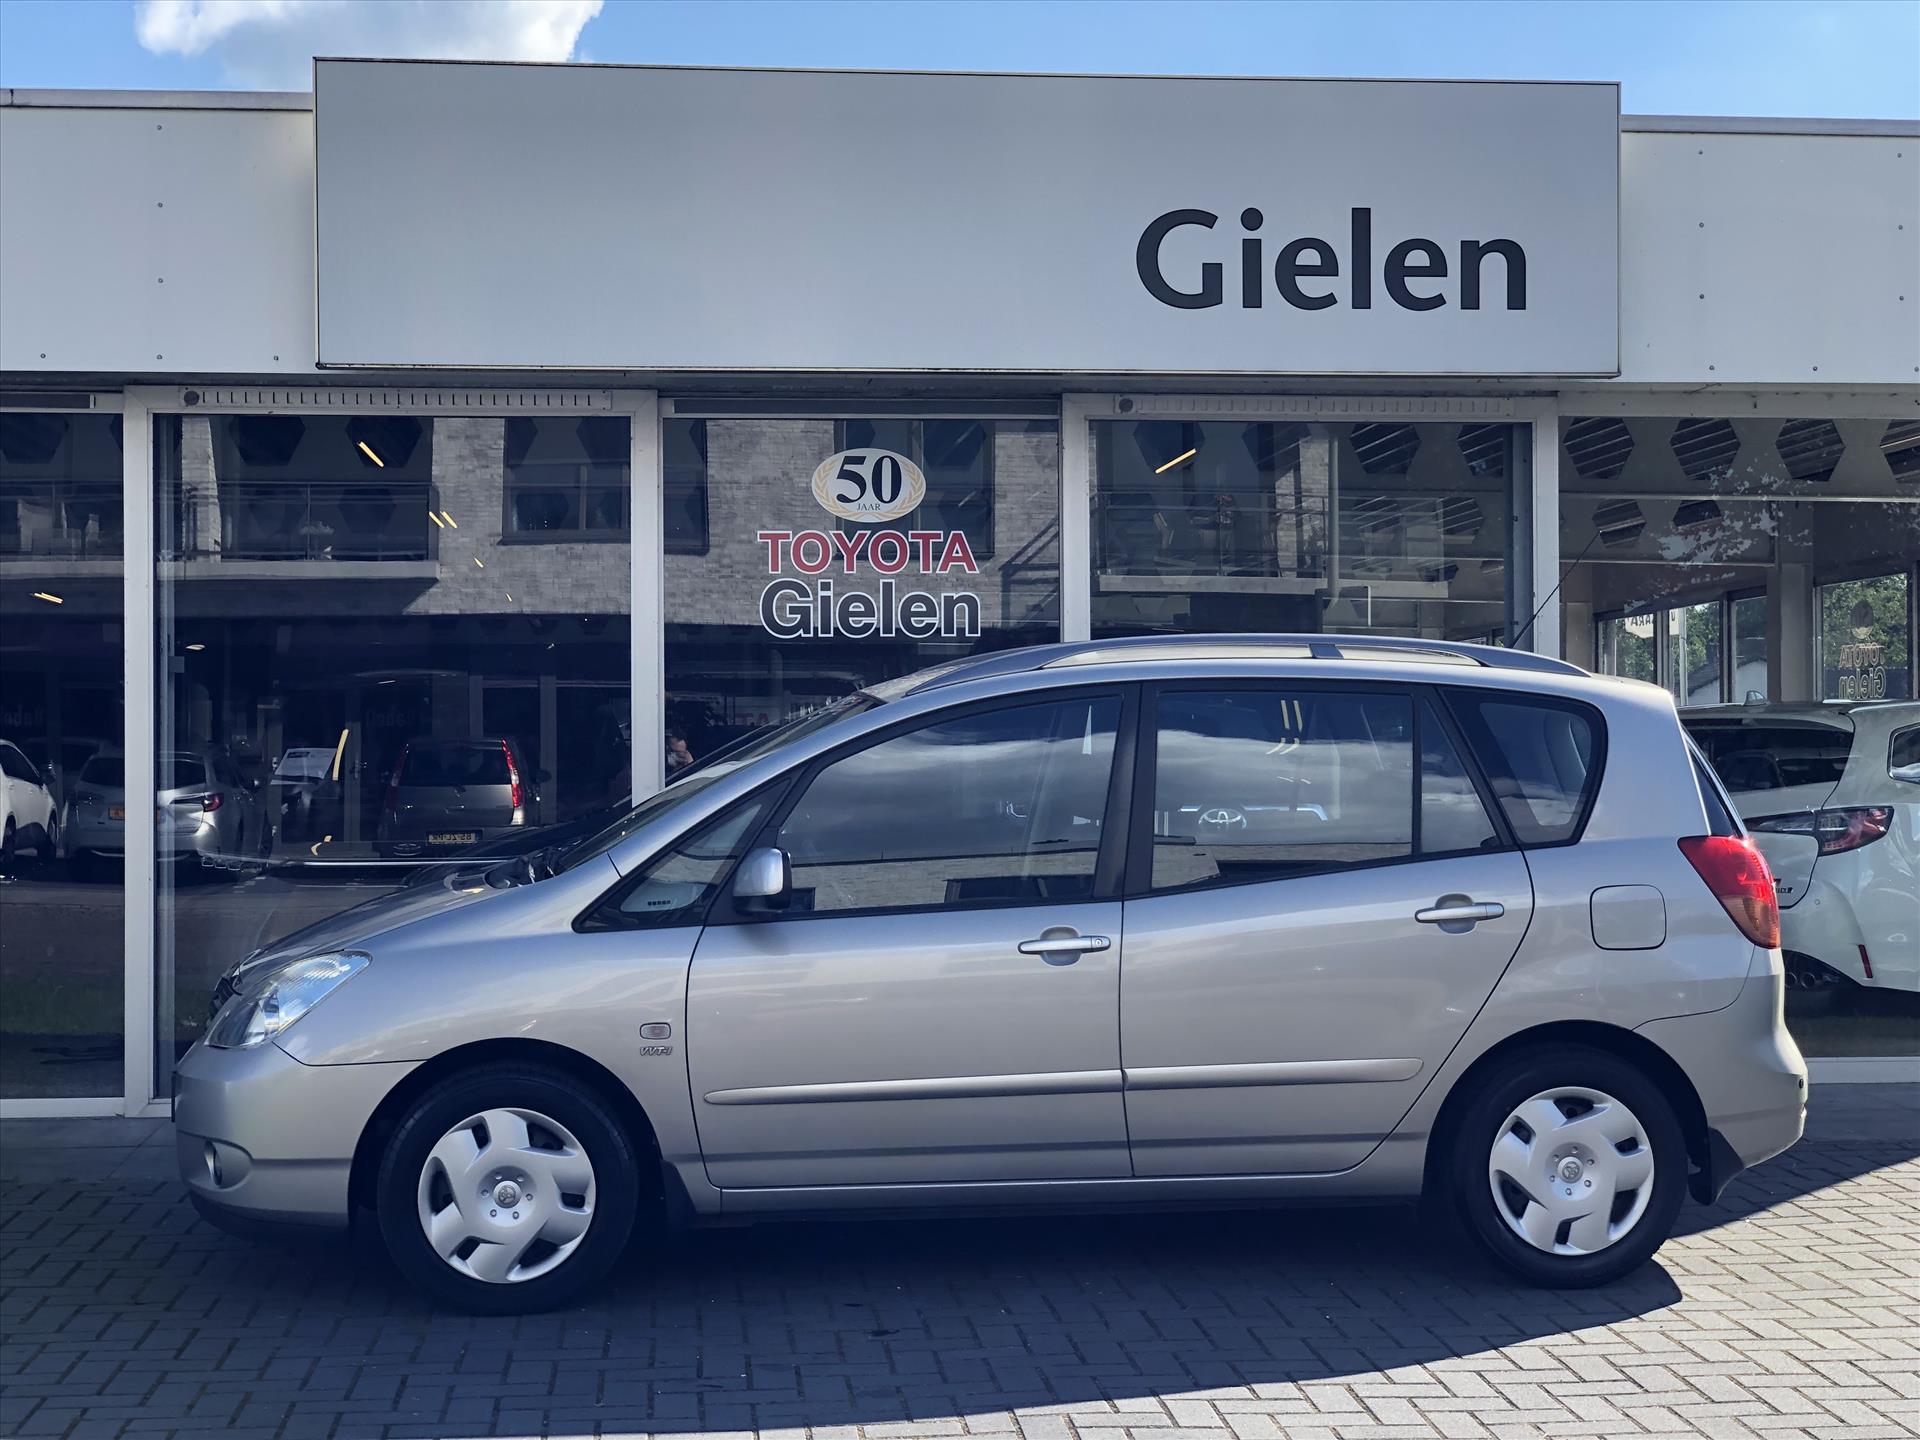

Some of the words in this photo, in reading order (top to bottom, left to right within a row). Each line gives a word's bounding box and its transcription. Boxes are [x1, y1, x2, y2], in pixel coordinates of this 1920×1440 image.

[1136, 207, 1526, 311] Gielen
[836, 455, 902, 504] 50
[856, 503, 881, 512] JAAR
[757, 530, 980, 575] TOYOTA
[759, 578, 981, 639] Gielen
